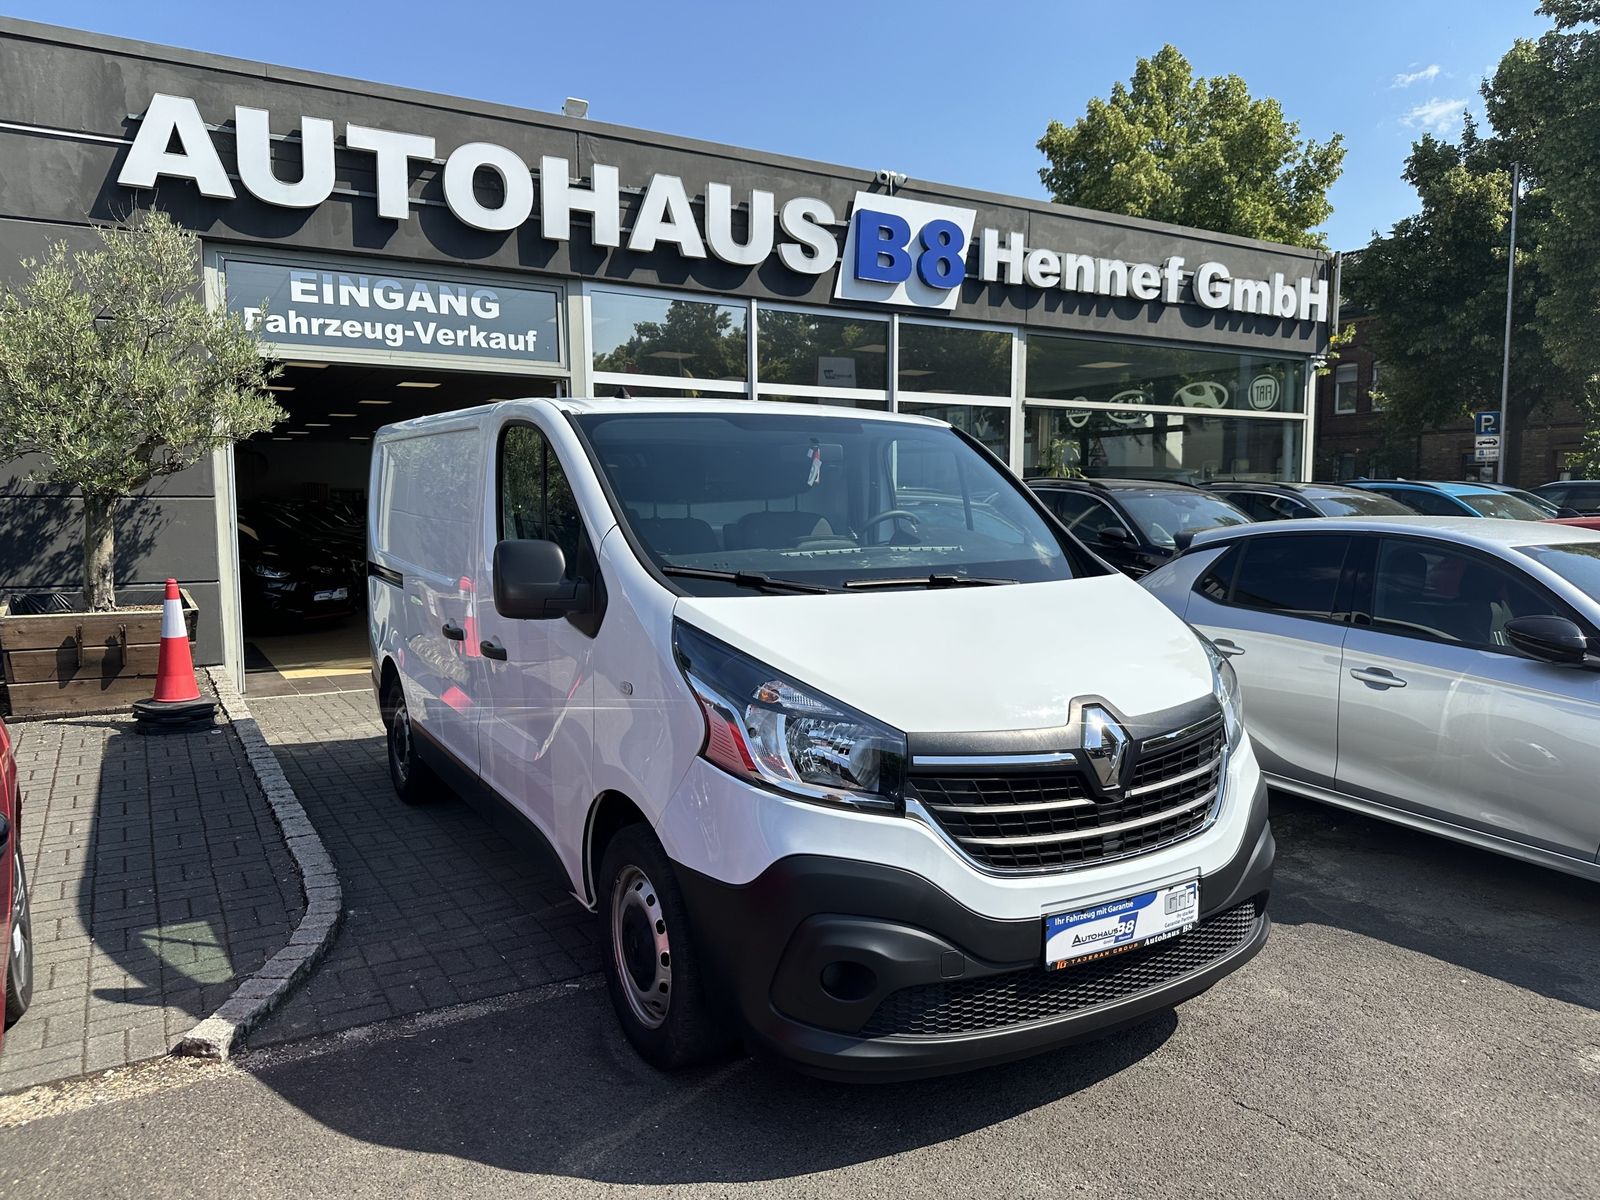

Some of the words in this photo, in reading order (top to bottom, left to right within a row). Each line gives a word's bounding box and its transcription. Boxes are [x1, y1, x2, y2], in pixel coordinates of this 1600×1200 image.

[117, 93, 840, 276] AUTOHAUS
[855, 208, 966, 291] B8
[979, 228, 1184, 304] Hennef
[1193, 262, 1329, 323] GmbH
[289, 270, 501, 320] EINGANG
[243, 306, 538, 352] Fahrzeug-Verkauf
[1480, 415, 1494, 432] P
[1054, 916, 1065, 926] Ihr
[1065, 911, 1096, 925] Fahrzeug
[1096, 907, 1107, 916] mit
[1107, 900, 1134, 912] Garantie
[1144, 929, 1180, 946] Autohaus
[1182, 923, 1193, 933] B8
[1113, 943, 1139, 954] GROUP
